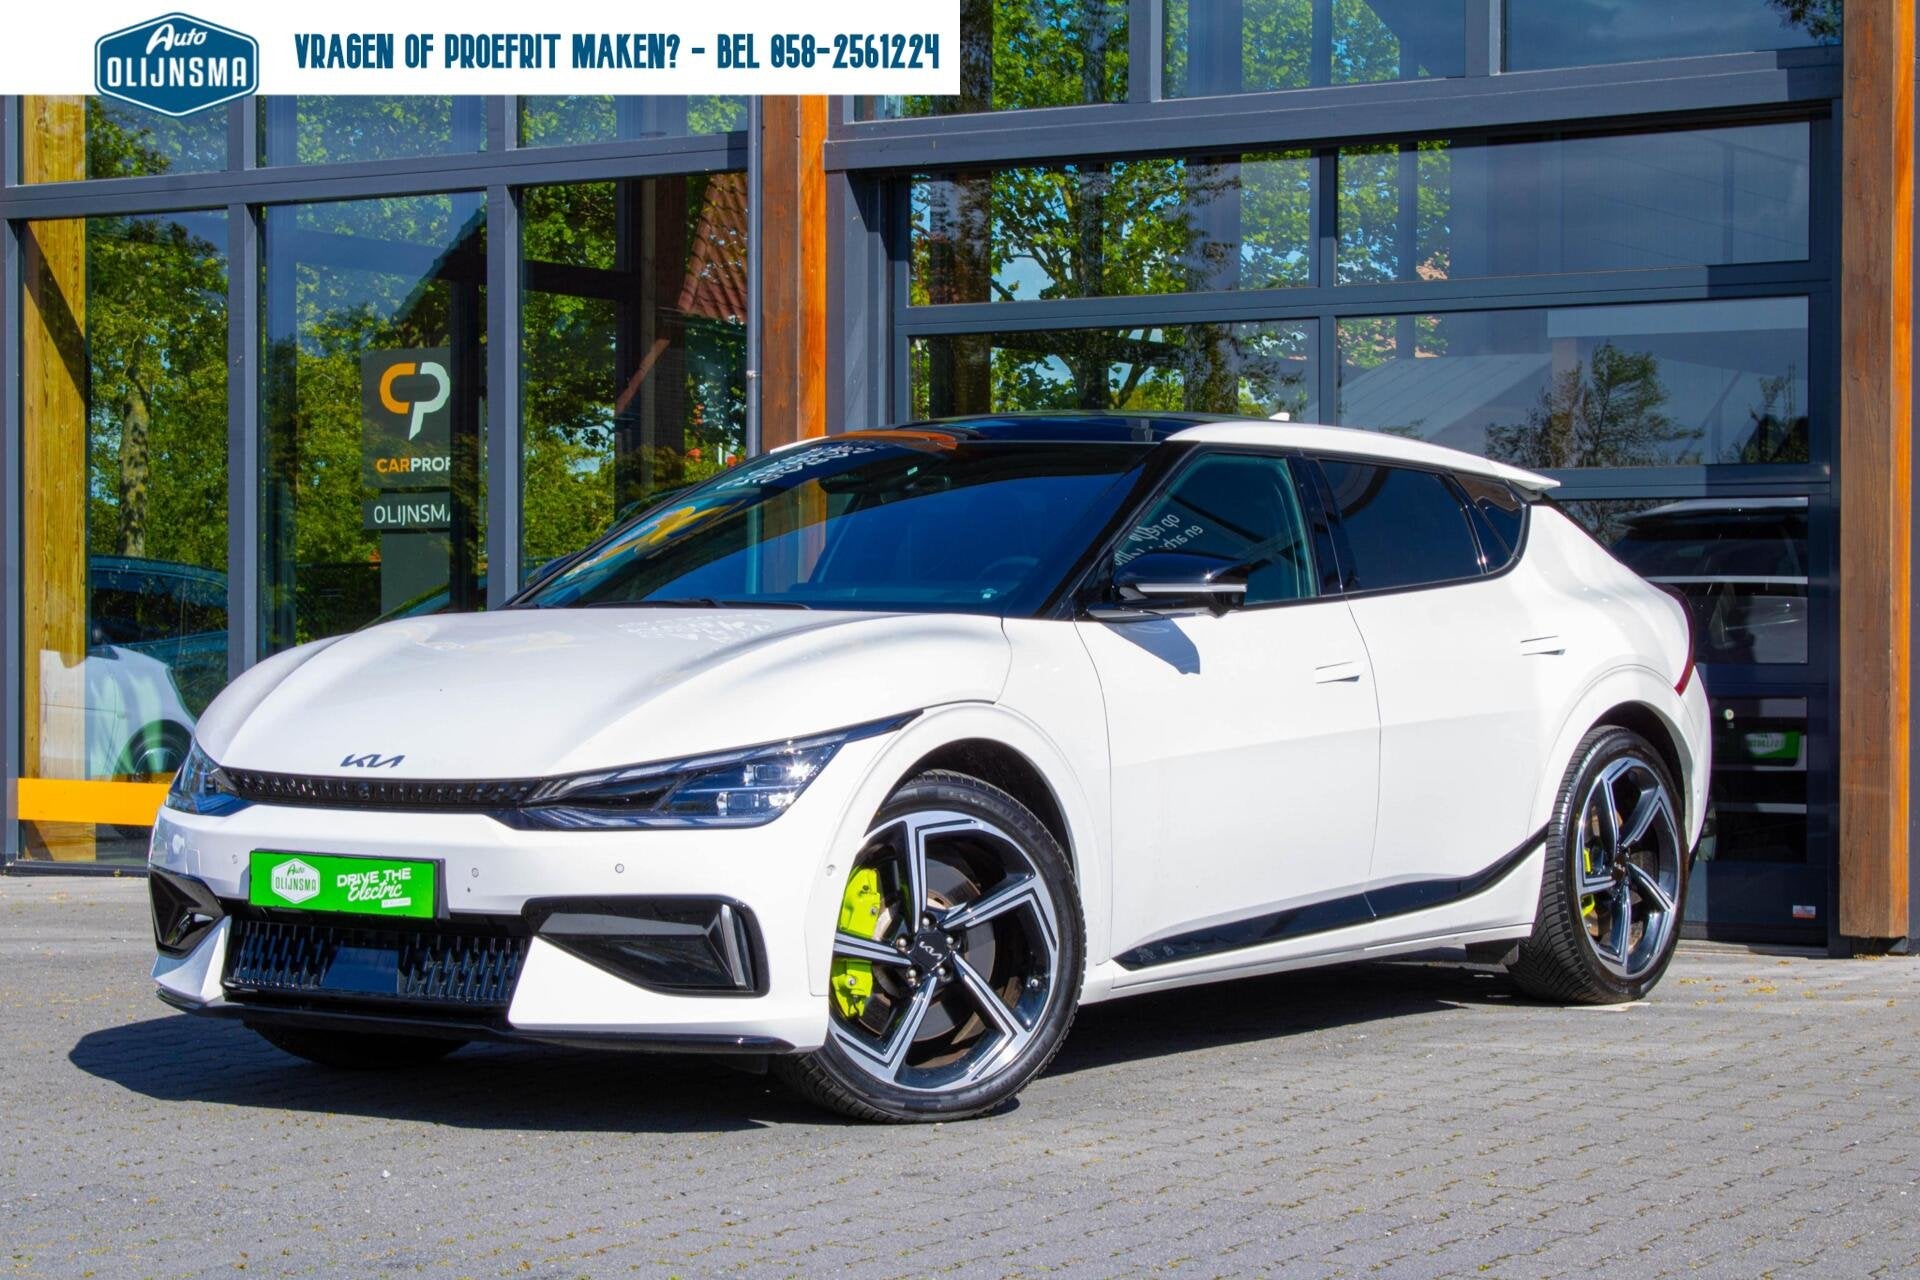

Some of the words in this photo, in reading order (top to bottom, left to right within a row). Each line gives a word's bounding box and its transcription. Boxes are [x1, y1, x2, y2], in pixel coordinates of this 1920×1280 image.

[374, 503, 451, 526] OLIJNSM
[337, 870, 380, 888] DRIVE
[383, 867, 412, 882] THE
[347, 880, 403, 902] Electric
